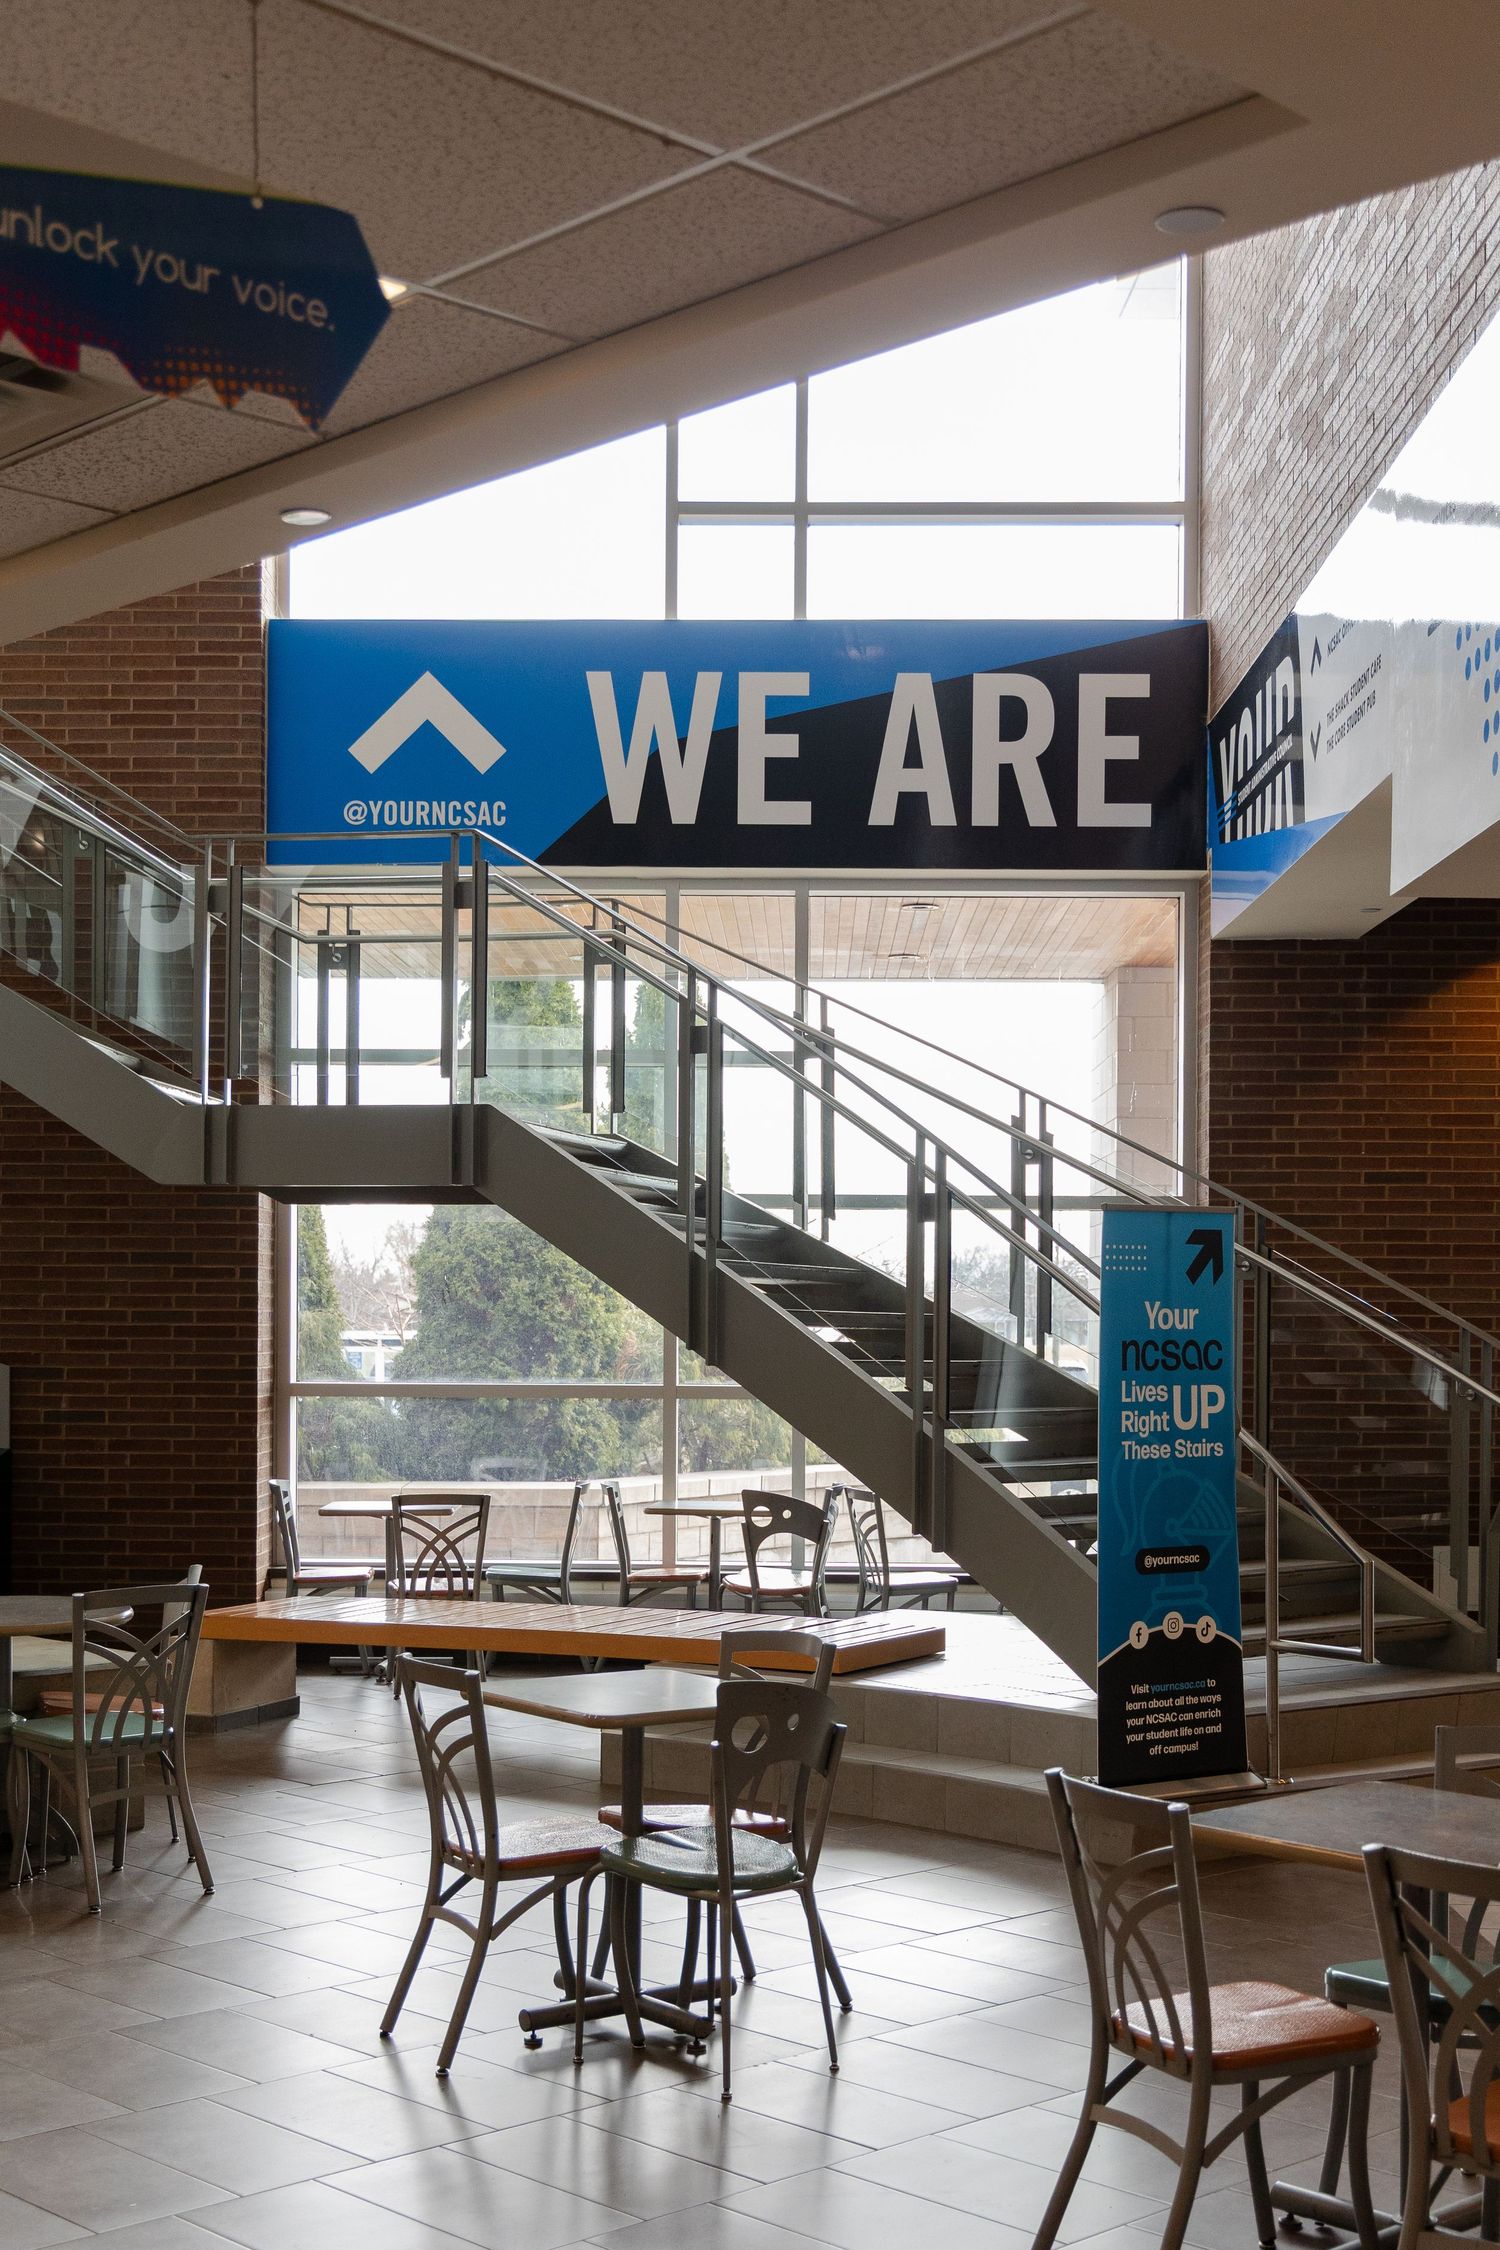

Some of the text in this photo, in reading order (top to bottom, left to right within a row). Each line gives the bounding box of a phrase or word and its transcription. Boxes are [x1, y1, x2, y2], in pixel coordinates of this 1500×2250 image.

[132, 245, 220, 295] your
[232, 275, 335, 332] voice.
[1326, 653, 1382, 728] THE SHACK STUDENT CAFE
[1326, 689, 1376, 754] THE CORE STUDENT PUB
[585, 670, 1152, 828] WE ARE
[343, 799, 508, 828] @YOURNCSAC
[1145, 1301, 1199, 1330] Your
[1121, 1339, 1223, 1371] ncsac
[1121, 1380, 1225, 1431] Lives UP
[1121, 1410, 1170, 1438] Right
[1121, 1438, 1224, 1460] These Stairs
[1144, 1553, 1200, 1568] @yourncsac
[1131, 1678, 1216, 1695] Visit yourncsac.ca to
[1125, 1693, 1222, 1711] learn about all the ways
[1126, 1708, 1221, 1729] your NCSAC can enrich
[1126, 1723, 1221, 1745] your student life on and
[1149, 1741, 1199, 1756] off campus!
